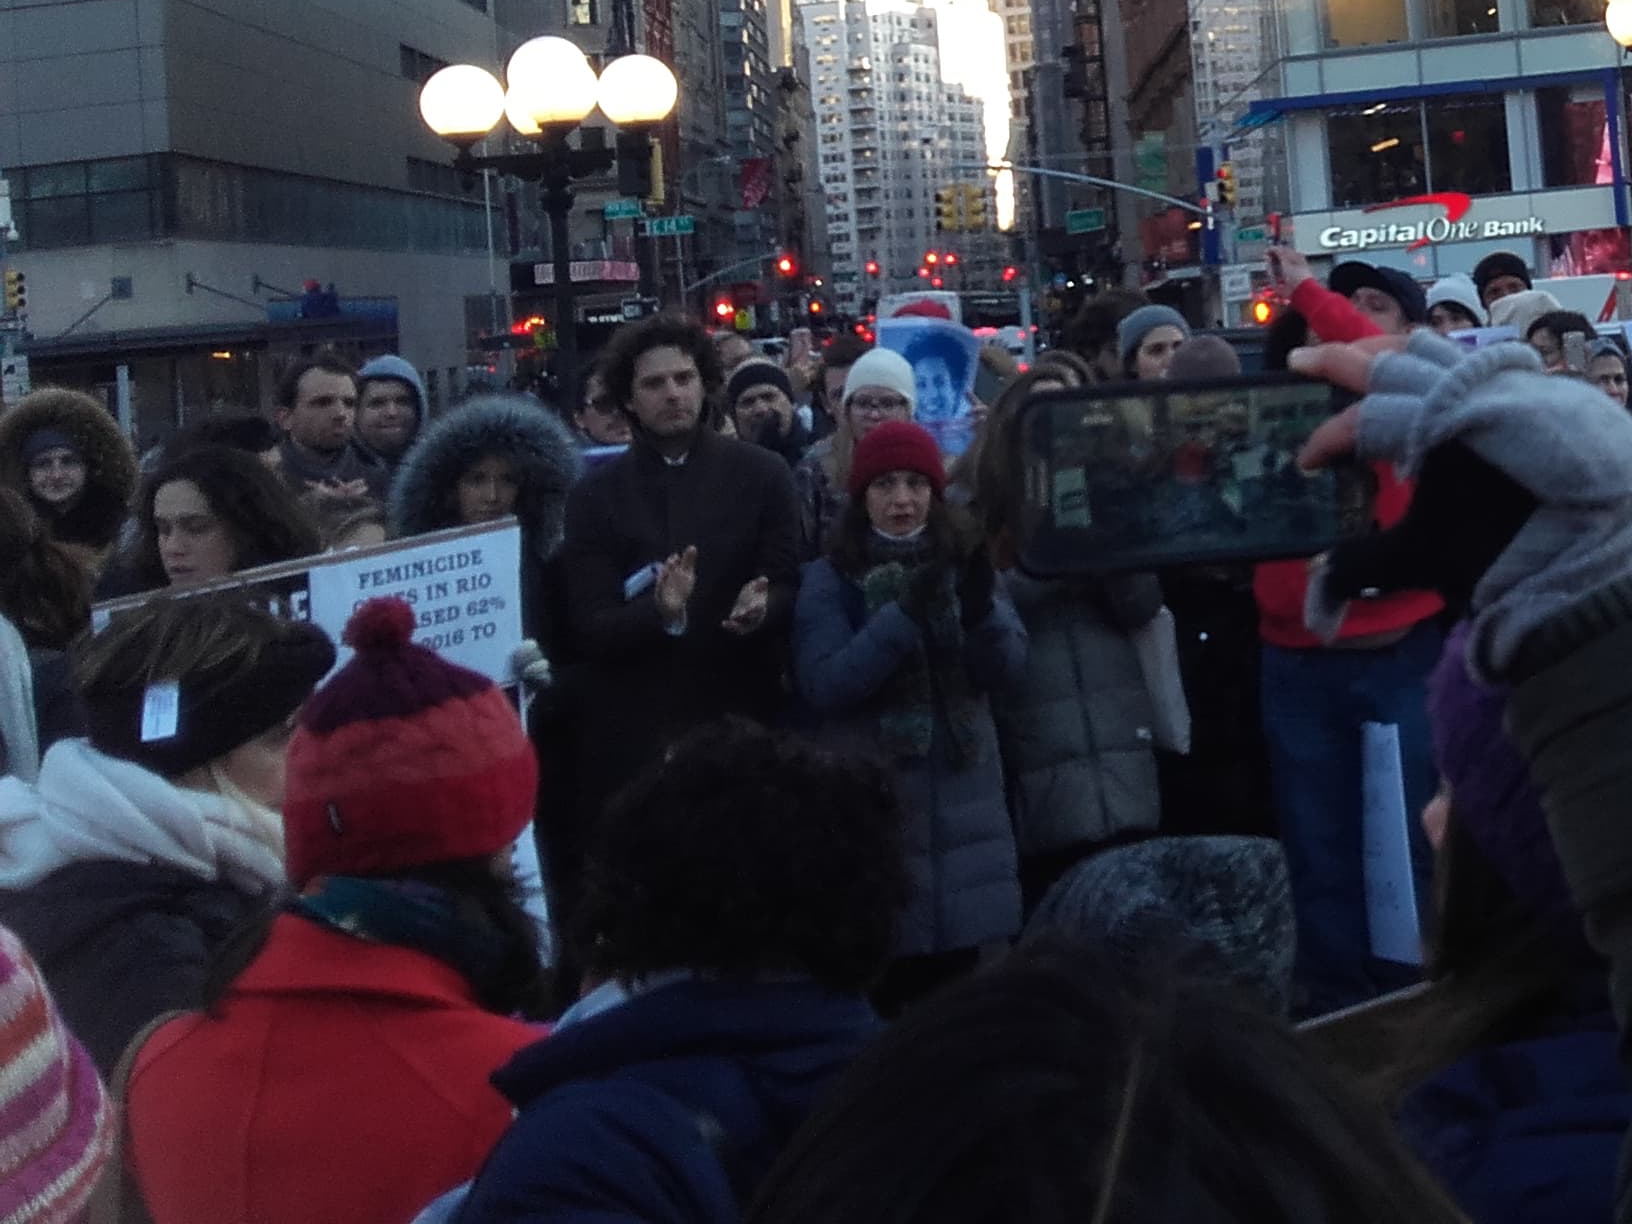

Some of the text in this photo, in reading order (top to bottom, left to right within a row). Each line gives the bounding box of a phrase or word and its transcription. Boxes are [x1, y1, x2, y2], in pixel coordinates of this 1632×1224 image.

[1483, 217, 1544, 237] Bank
[358, 549, 483, 590] FEMINICIDE
[426, 582, 449, 601] IN
[455, 573, 493, 594] RIO
[471, 622, 497, 642] TO
